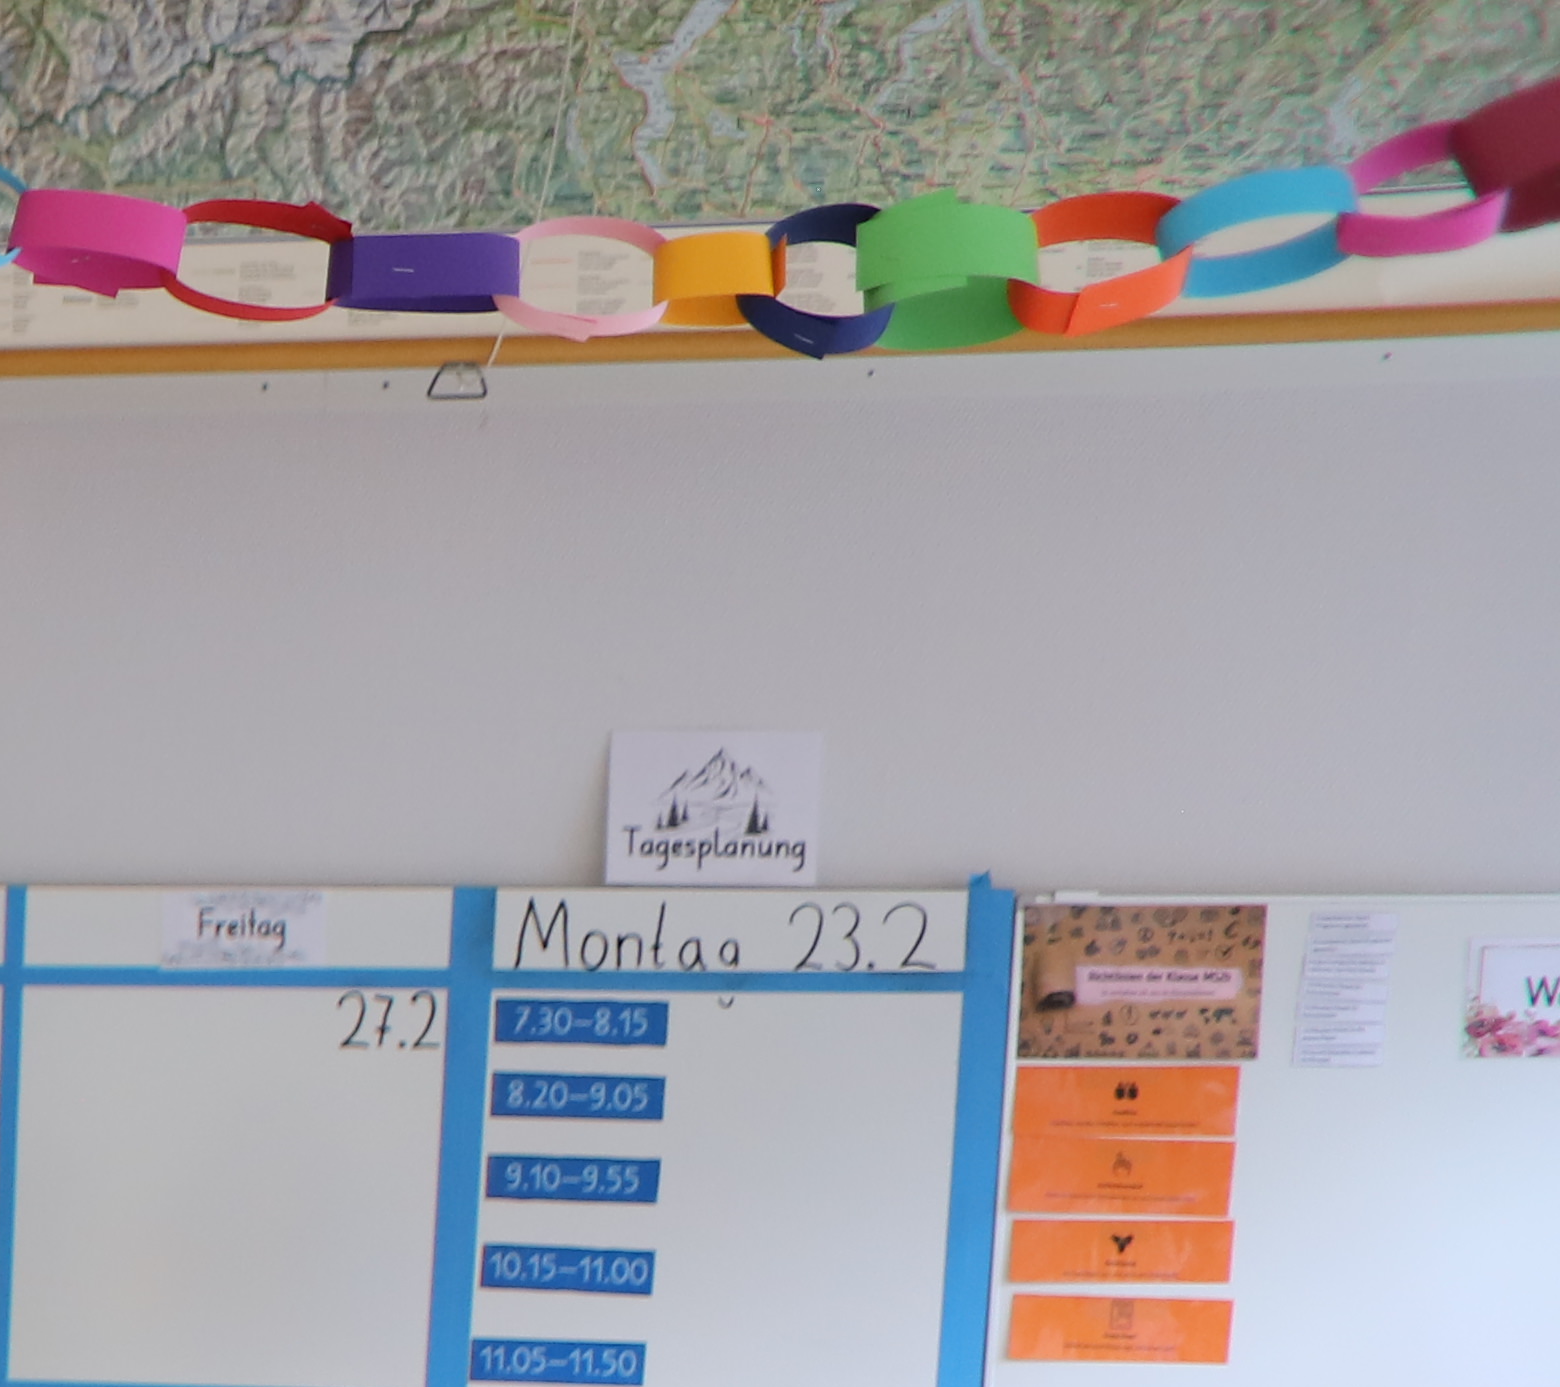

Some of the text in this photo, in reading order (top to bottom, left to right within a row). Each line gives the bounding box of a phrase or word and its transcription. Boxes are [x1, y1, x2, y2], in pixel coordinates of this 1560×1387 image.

[623, 827, 807, 870] Tagesplanung
[196, 906, 287, 950] Freitag
[514, 897, 937, 1009] Montag 23.2
[336, 989, 441, 1050] 27.2
